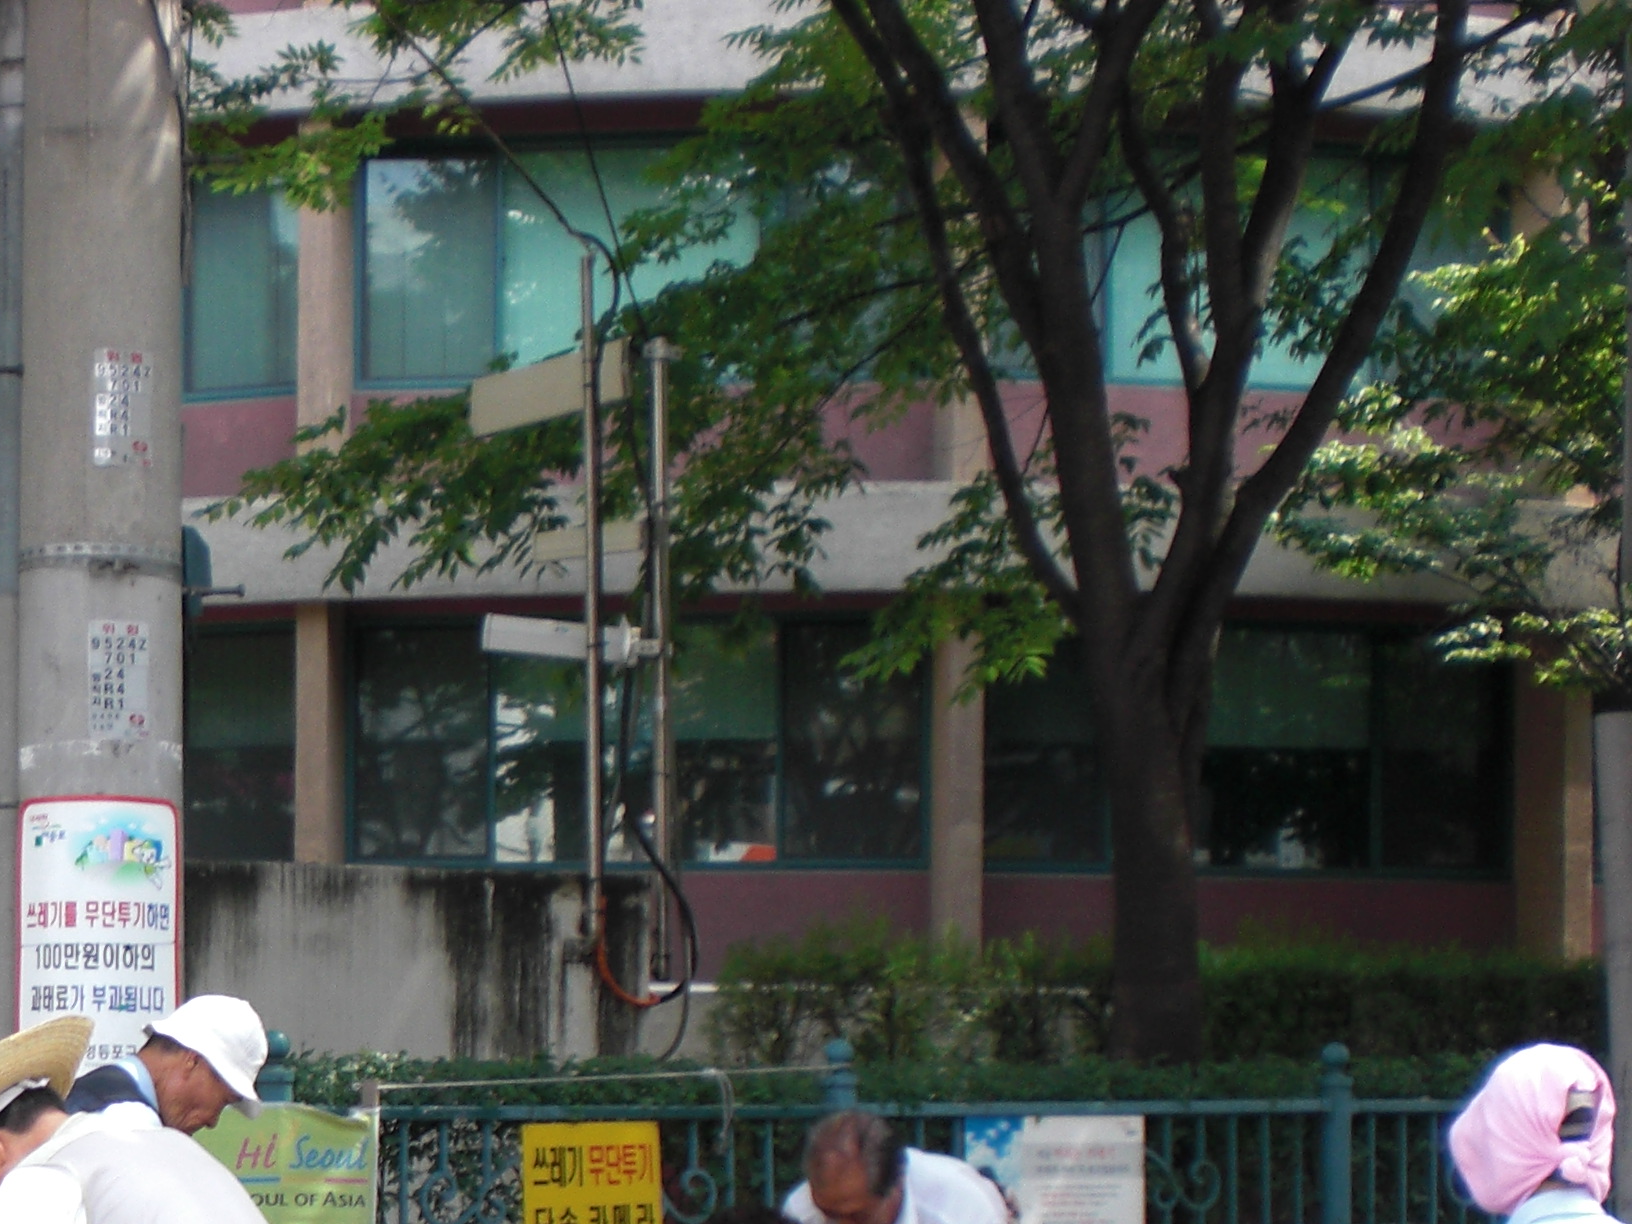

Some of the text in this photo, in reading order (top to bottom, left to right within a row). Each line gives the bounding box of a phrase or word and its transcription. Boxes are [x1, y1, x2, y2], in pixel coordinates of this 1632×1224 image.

[26, 901, 170, 931] 쓰레기를 무단투기하면
[35, 943, 156, 972] 100만원이하의
[31, 985, 165, 1013] 과태료가 부과됩니다
[235, 1133, 368, 1170] Hi Seoul
[533, 1144, 655, 1187] 쓰레기 무단투기
